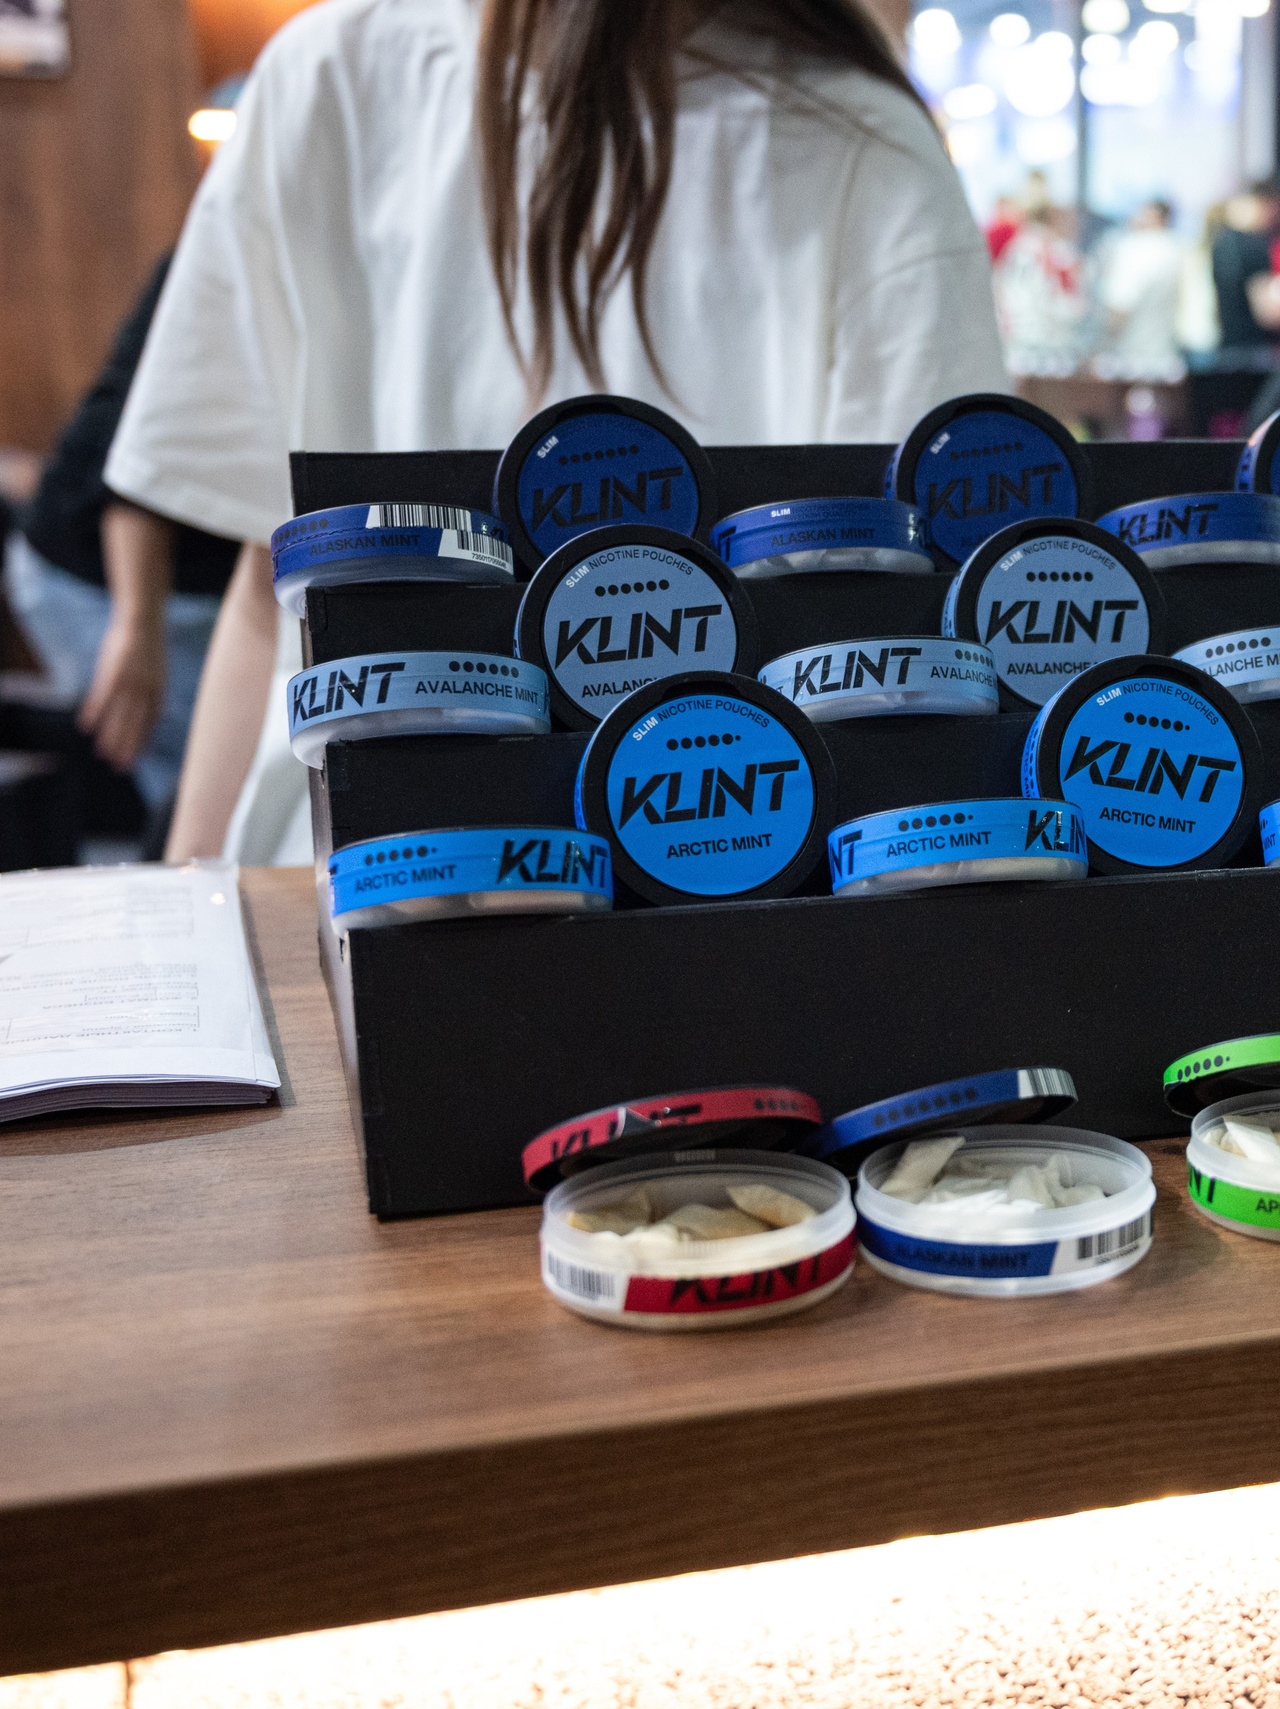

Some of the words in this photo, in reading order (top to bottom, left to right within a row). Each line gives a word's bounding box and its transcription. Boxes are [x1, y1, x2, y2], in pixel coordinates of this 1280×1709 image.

[536, 434, 560, 459] SLIM
[532, 465, 683, 533] KLINT
[928, 462, 1063, 520] KLINT
[770, 507, 791, 518] SLIM
[1118, 503, 1219, 545] KLINT
[309, 536, 375, 556] ALASKAN
[380, 533, 420, 548] MINT
[771, 529, 836, 547] ALASKAN
[840, 528, 875, 540] MINT
[1000, 551, 1024, 571] SLIM
[1022, 540, 1070, 556] NICOTINE
[1071, 542, 1117, 571] POUCHES
[565, 565, 590, 588] SLIM
[588, 549, 640, 570] NICOTINE
[642, 549, 694, 576] POUCHES
[555, 604, 723, 670] KLINT
[985, 600, 1139, 646] KLINT
[293, 662, 406, 728] KLINT
[415, 680, 513, 698] AVALANCHE
[515, 686, 539, 705] MINT
[581, 676, 661, 698] AVALAN
[792, 647, 922, 701] KLINT
[930, 666, 993, 687] AVALANCHE
[632, 716, 659, 741] SLIM
[657, 699, 713, 722] NICOTINE
[715, 700, 770, 728] POUCHES
[1096, 687, 1122, 706] SLIM
[1122, 682, 1173, 696] NICOTINE
[1174, 688, 1219, 726] POUCHES
[1063, 736, 1237, 803] KLINT
[618, 759, 799, 831] KLINT
[886, 835, 946, 858] ARCTIC
[950, 831, 992, 848] MINT
[1025, 809, 1086, 856] KLIN
[1099, 807, 1155, 828] ARCTIC
[1158, 815, 1196, 834] MINT
[666, 838, 728, 859] ARCTIC
[731, 833, 773, 851] MINT
[354, 868, 408, 893] ARCTIC
[412, 864, 457, 884] MINT
